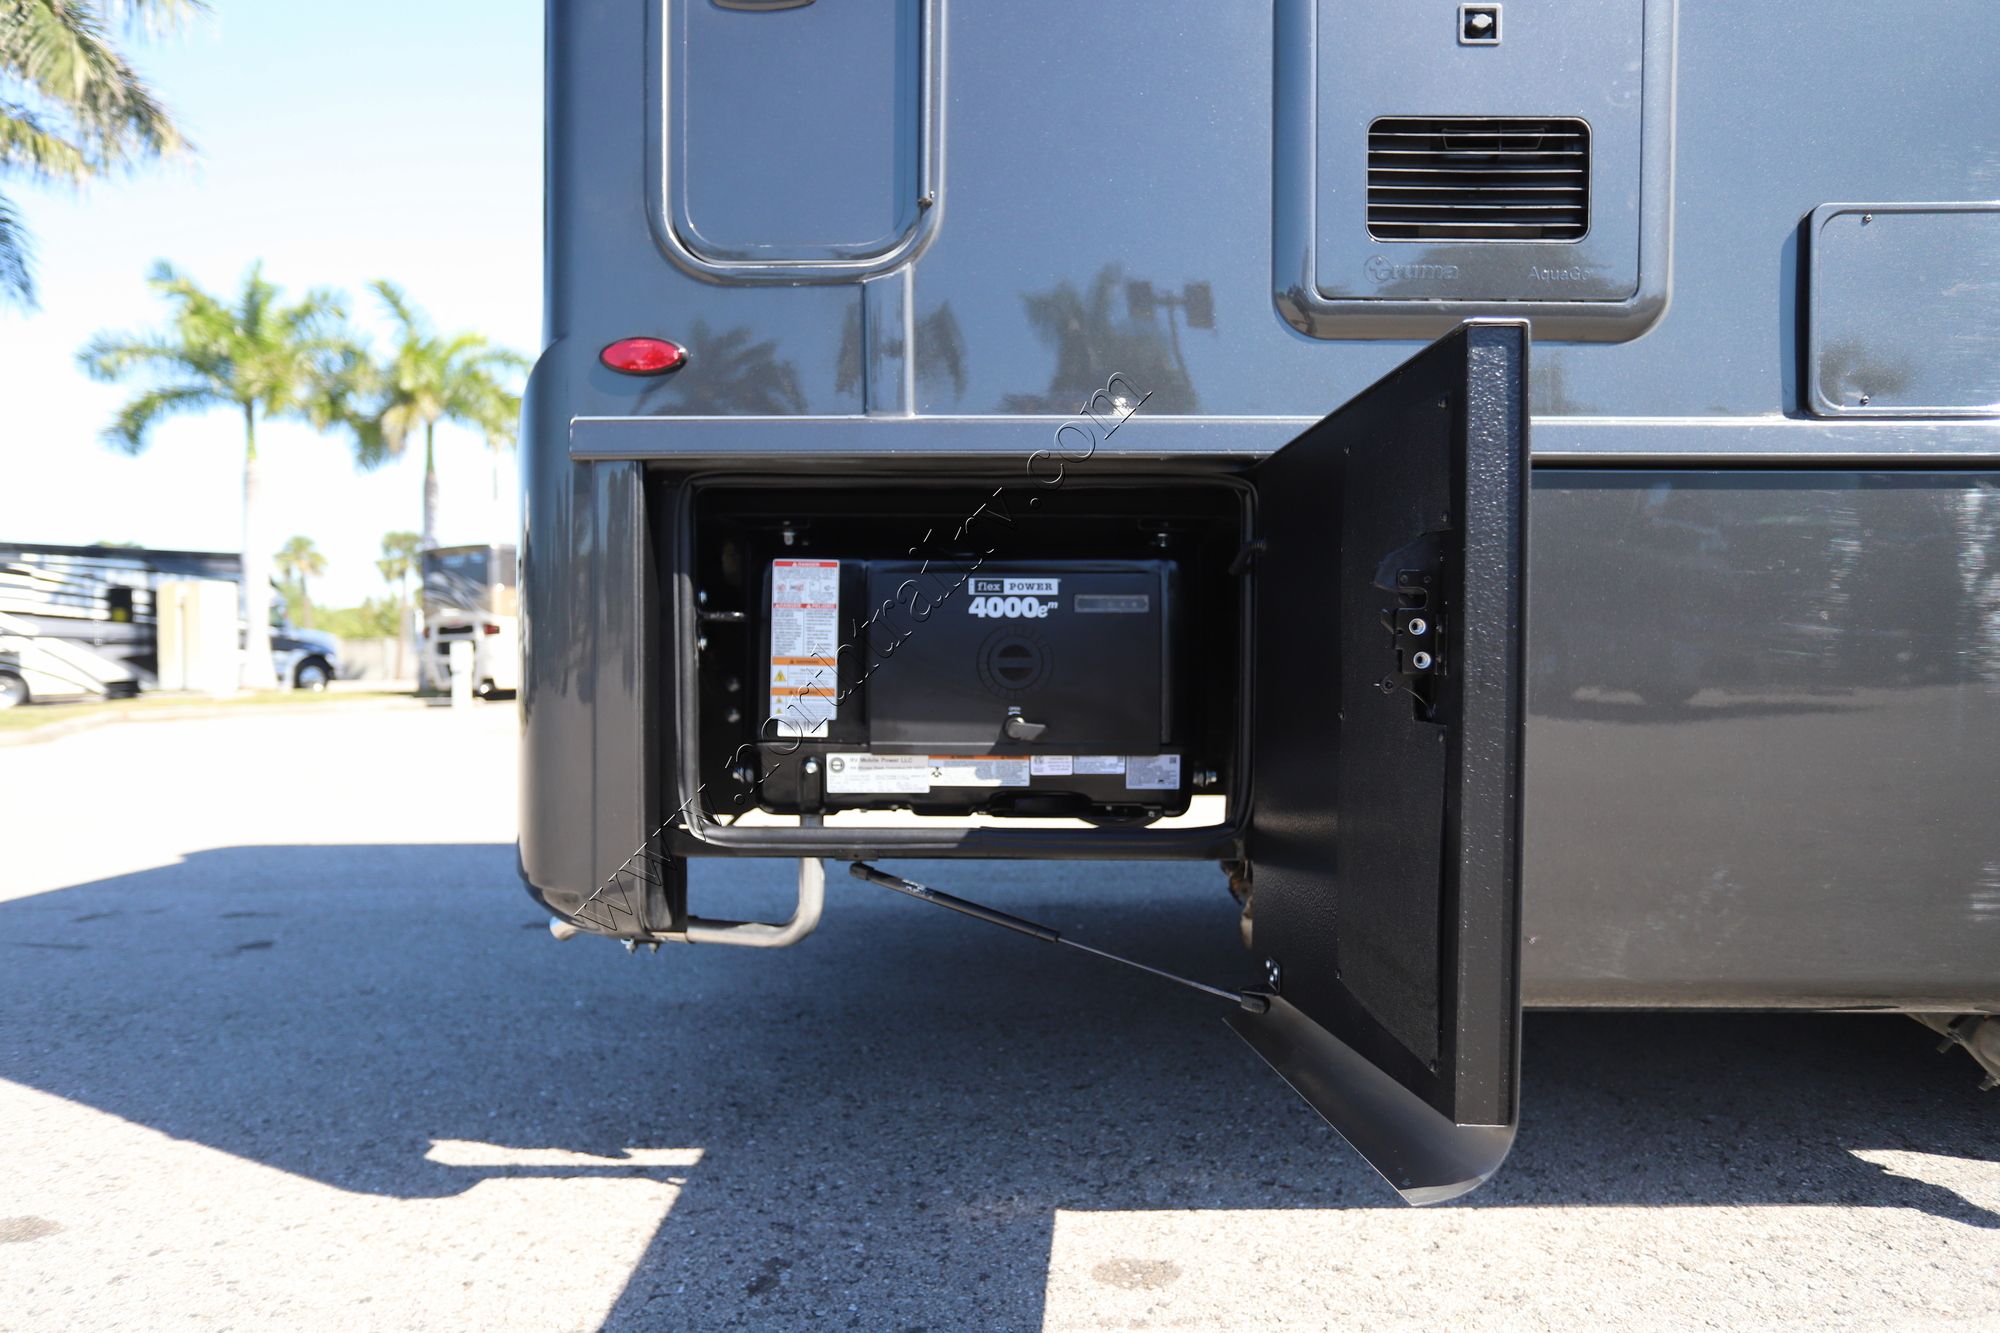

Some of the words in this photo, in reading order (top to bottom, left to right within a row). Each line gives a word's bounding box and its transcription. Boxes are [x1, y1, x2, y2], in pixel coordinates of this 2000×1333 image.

[1527, 265, 1591, 283] AquaGo
[976, 581, 1001, 592] flex
[1009, 582, 1053, 591] POWER
